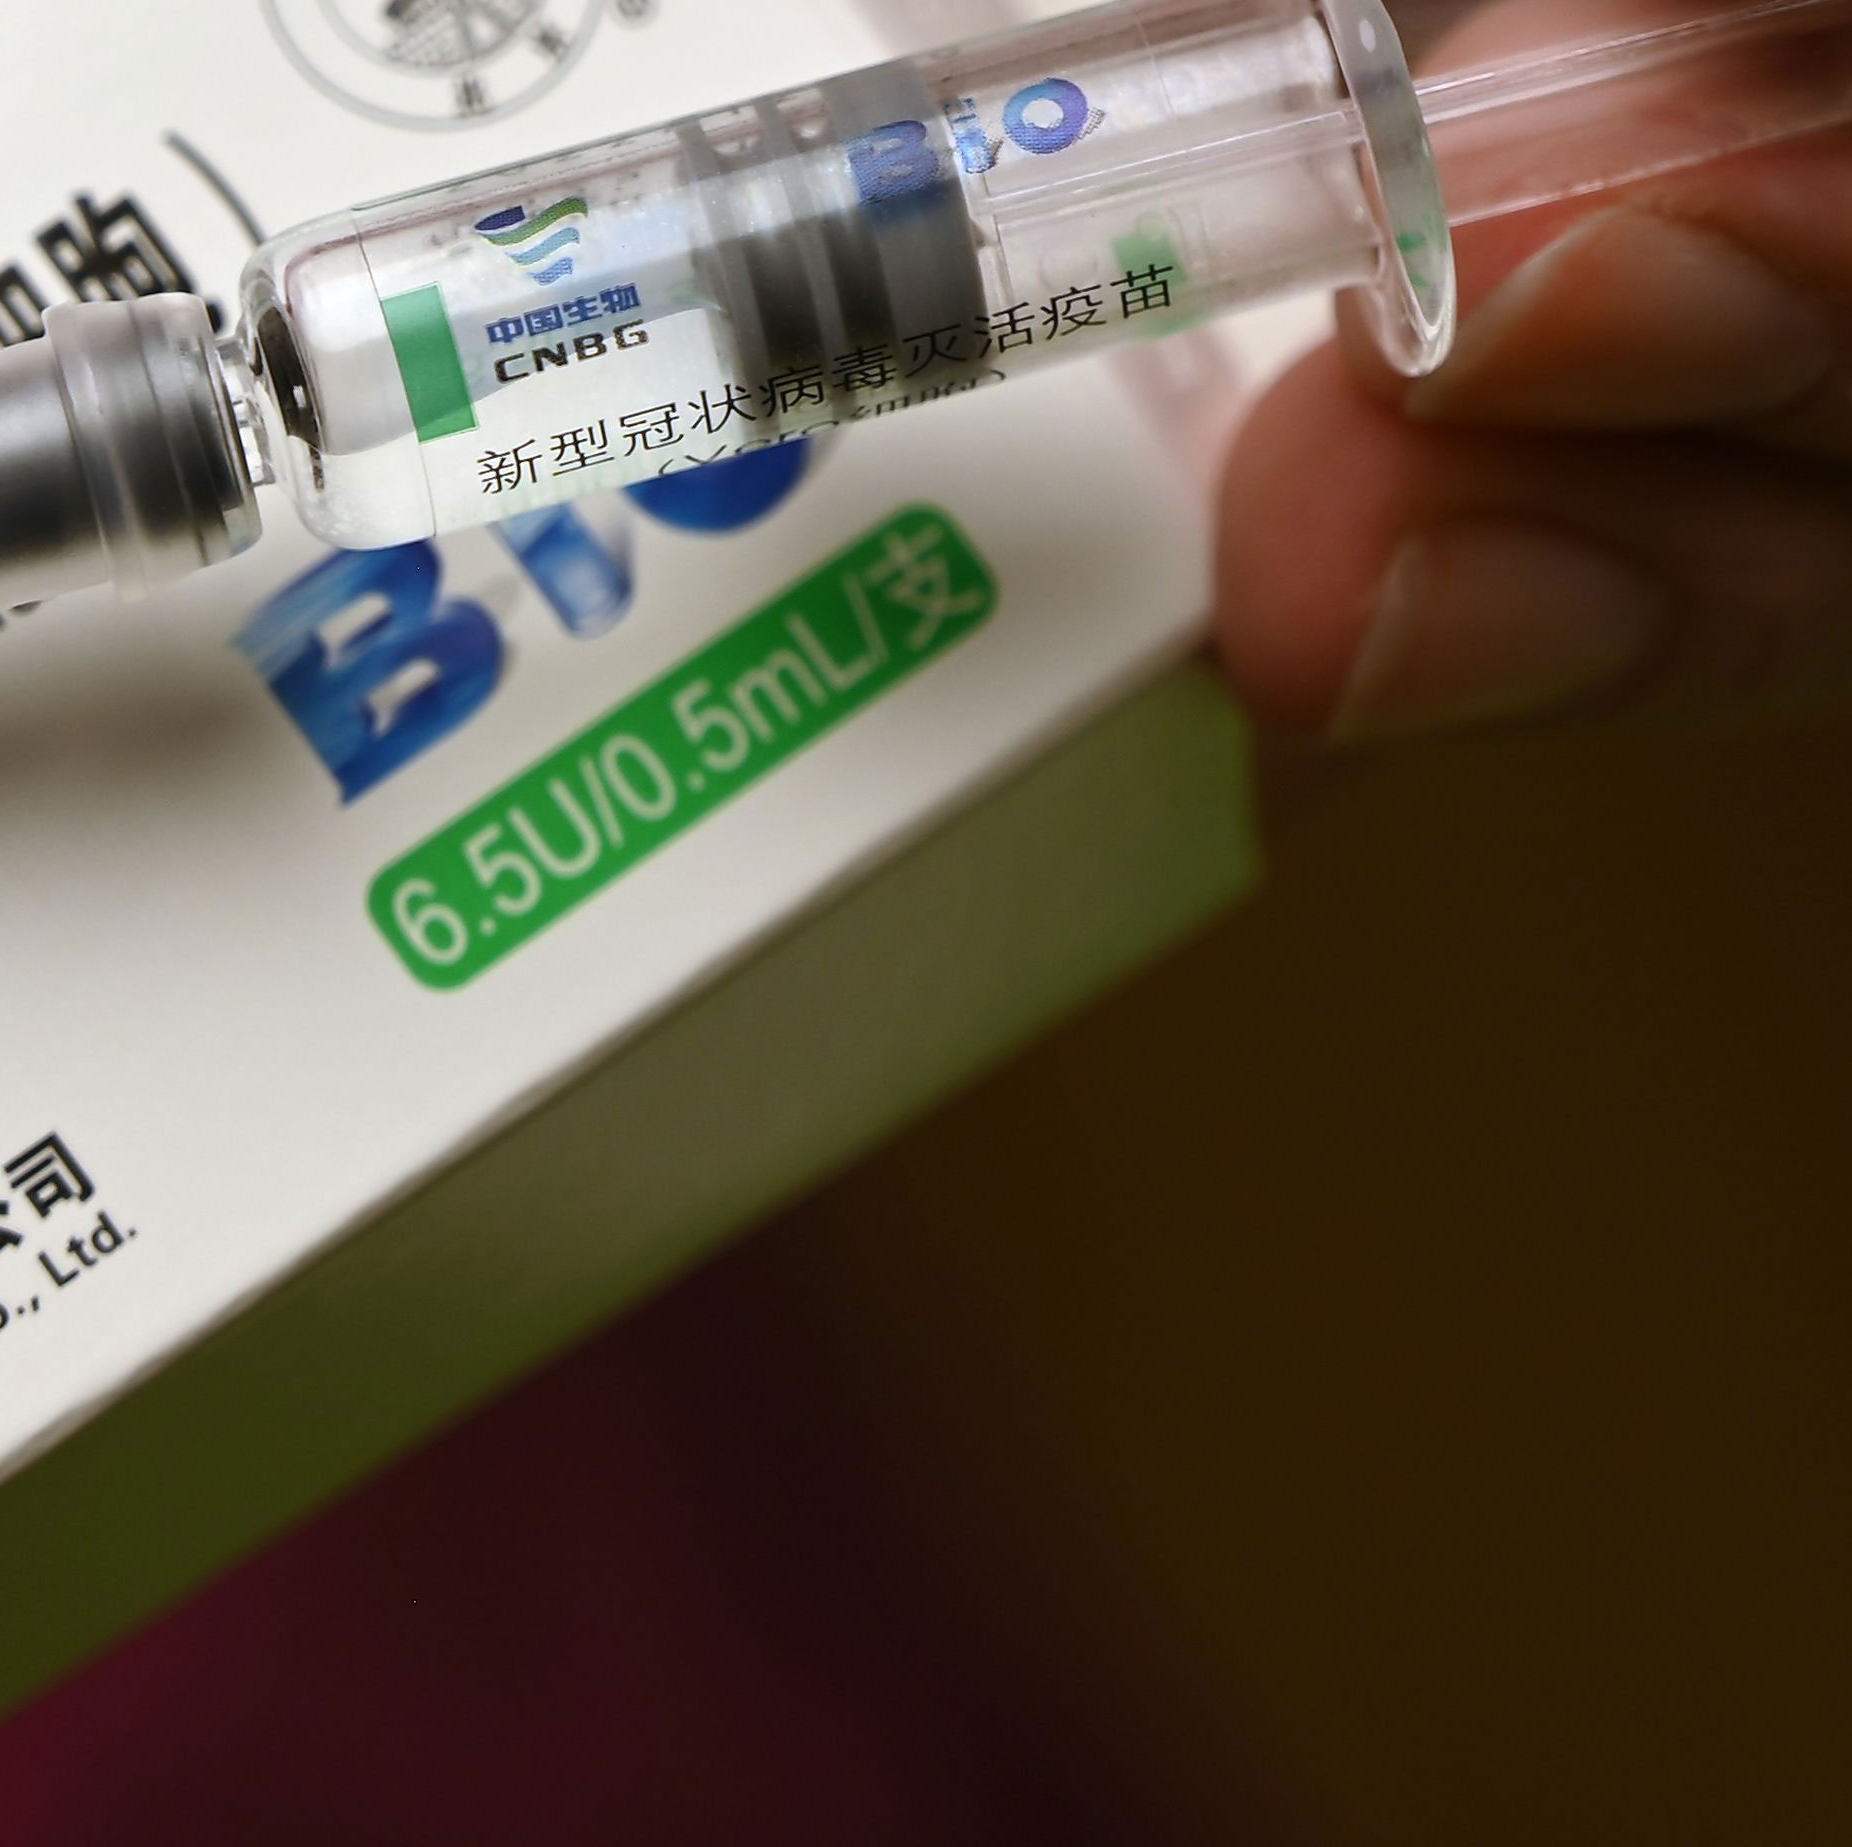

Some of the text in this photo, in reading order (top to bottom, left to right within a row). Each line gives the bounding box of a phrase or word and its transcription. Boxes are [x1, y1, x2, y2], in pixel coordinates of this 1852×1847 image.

[485, 282, 641, 344] 中国生物
[494, 318, 648, 383] CNBG
[477, 263, 1175, 494] 新型冠状病毒灭活疫苗
[392, 523, 985, 967] 6.5U/0.5mL/支
[38, 1214, 138, 1290] Ltd.
